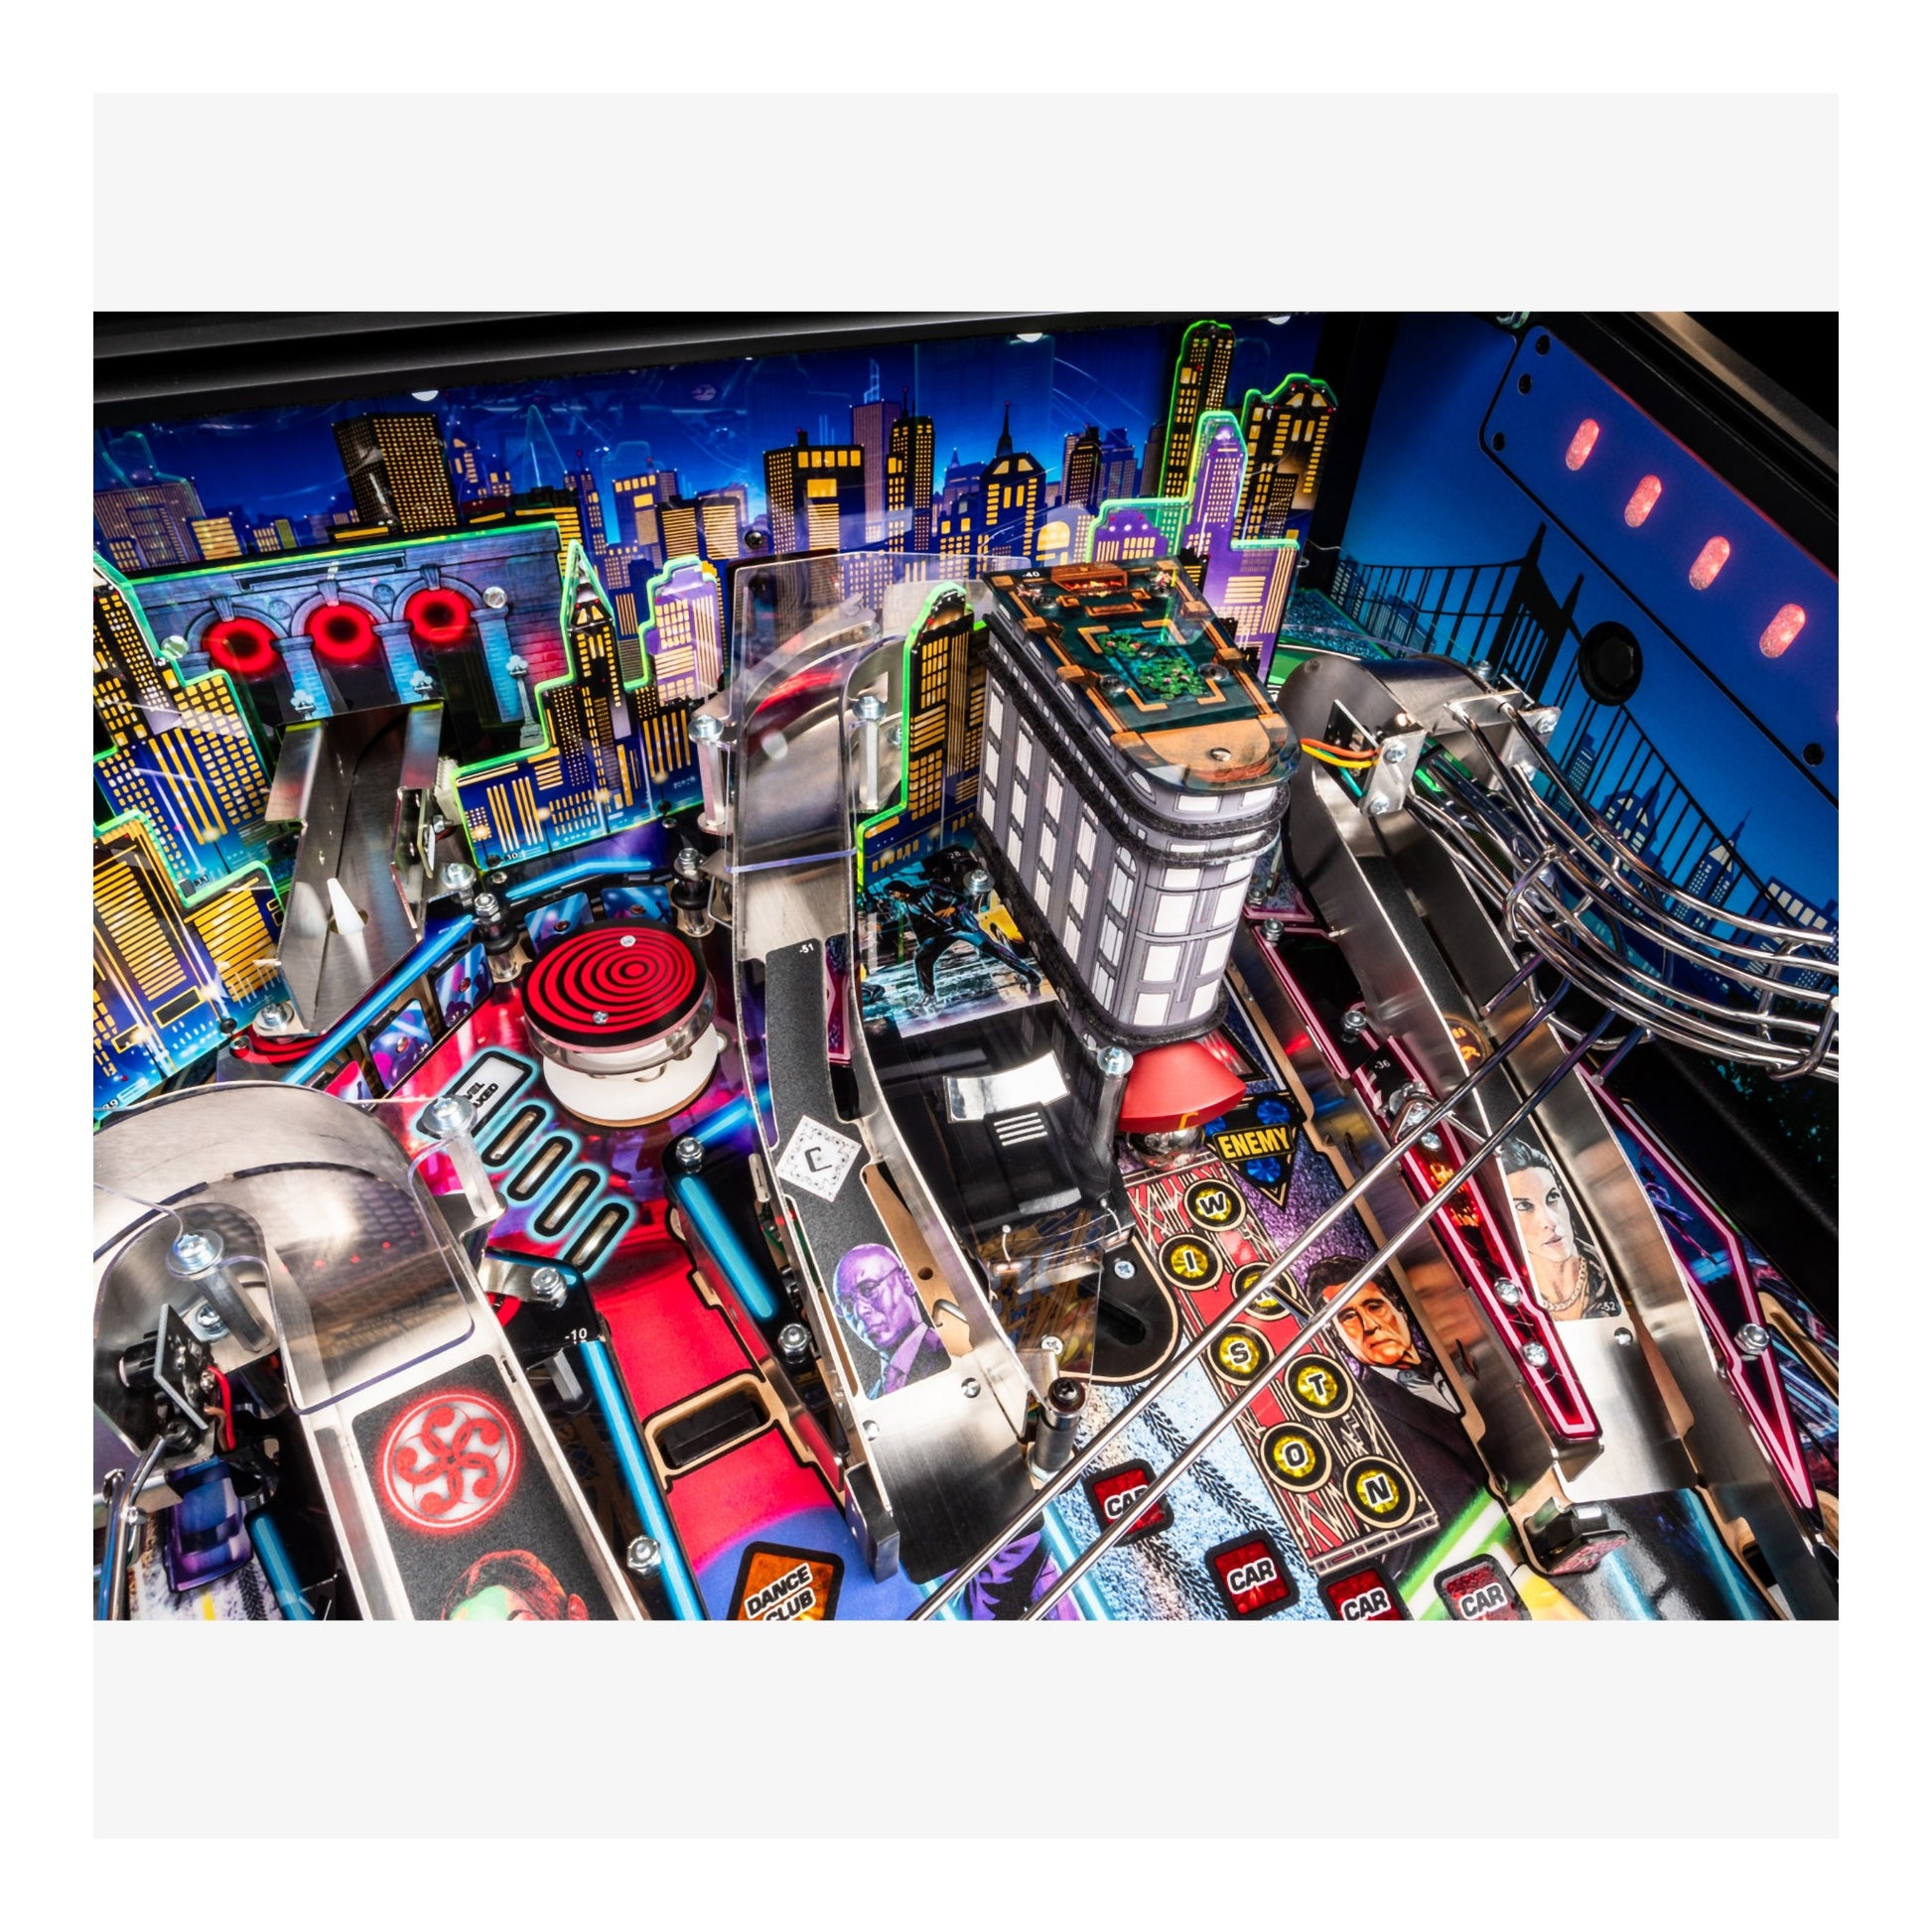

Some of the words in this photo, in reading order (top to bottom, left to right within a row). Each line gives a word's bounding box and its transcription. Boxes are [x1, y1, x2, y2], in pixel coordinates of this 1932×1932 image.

[799, 943, 814, 953] -51
[1217, 1127, 1290, 1159] ENEMY
[1198, 1192, 1226, 1216] W
[1184, 1251, 1196, 1271] I
[1600, 1301, 1617, 1311] -52
[565, 1327, 588, 1340] -10
[1230, 1342, 1250, 1364] S
[1308, 1373, 1325, 1397] T
[1364, 1475, 1392, 1505] N
[1229, 1559, 1275, 1591] CAR
[747, 1565, 811, 1616] DANCE
[1461, 1585, 1506, 1618] CAR
[765, 1589, 814, 1621] CLUB
[1343, 1589, 1389, 1620] CAR
